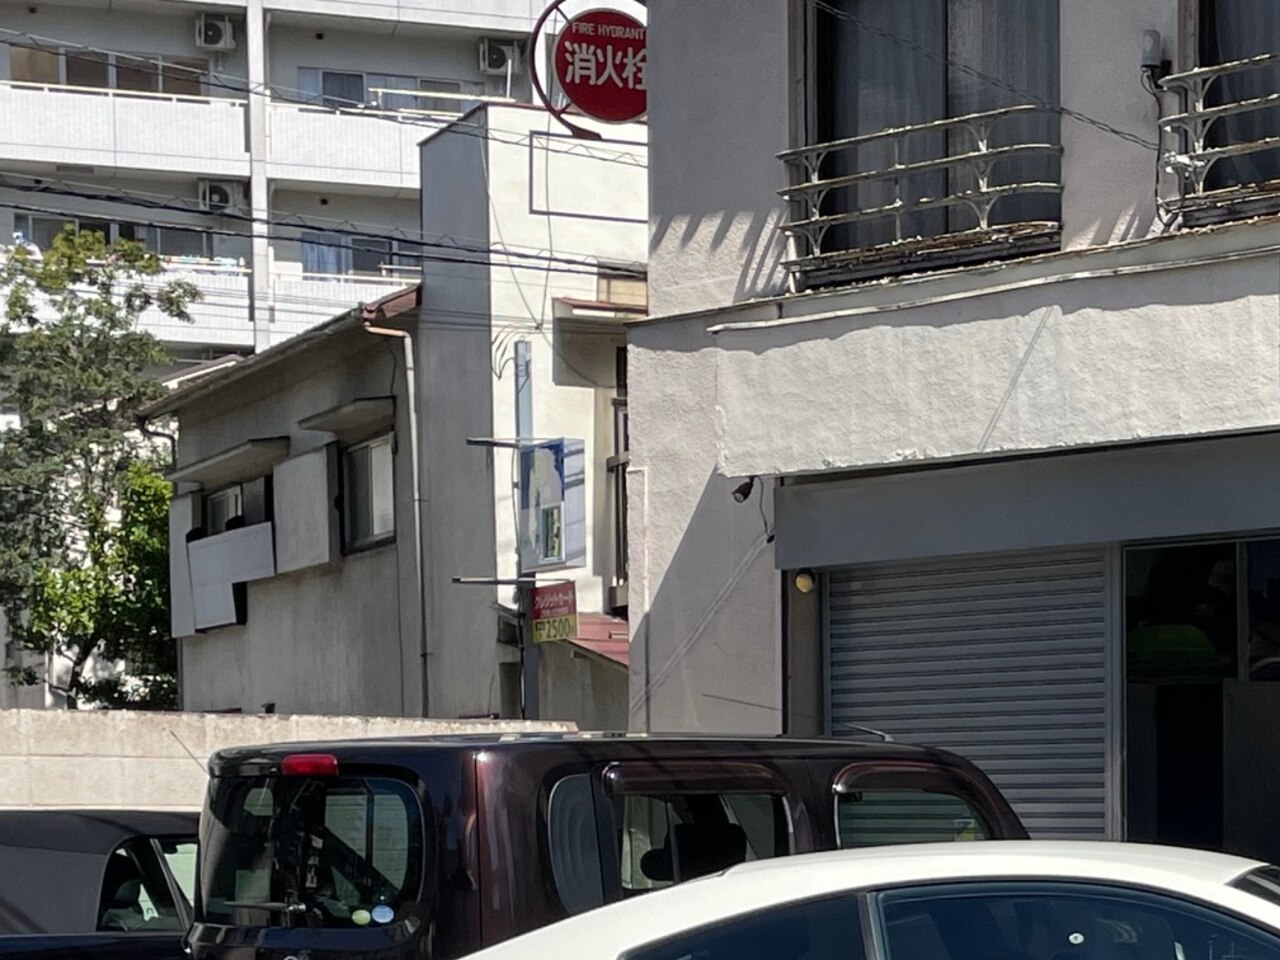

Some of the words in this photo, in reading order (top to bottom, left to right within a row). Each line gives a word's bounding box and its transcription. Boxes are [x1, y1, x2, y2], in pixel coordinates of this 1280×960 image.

[571, 22, 595, 36] FIRE
[598, 25, 645, 40] HYDRANT
[564, 41, 648, 91] 消火栓
